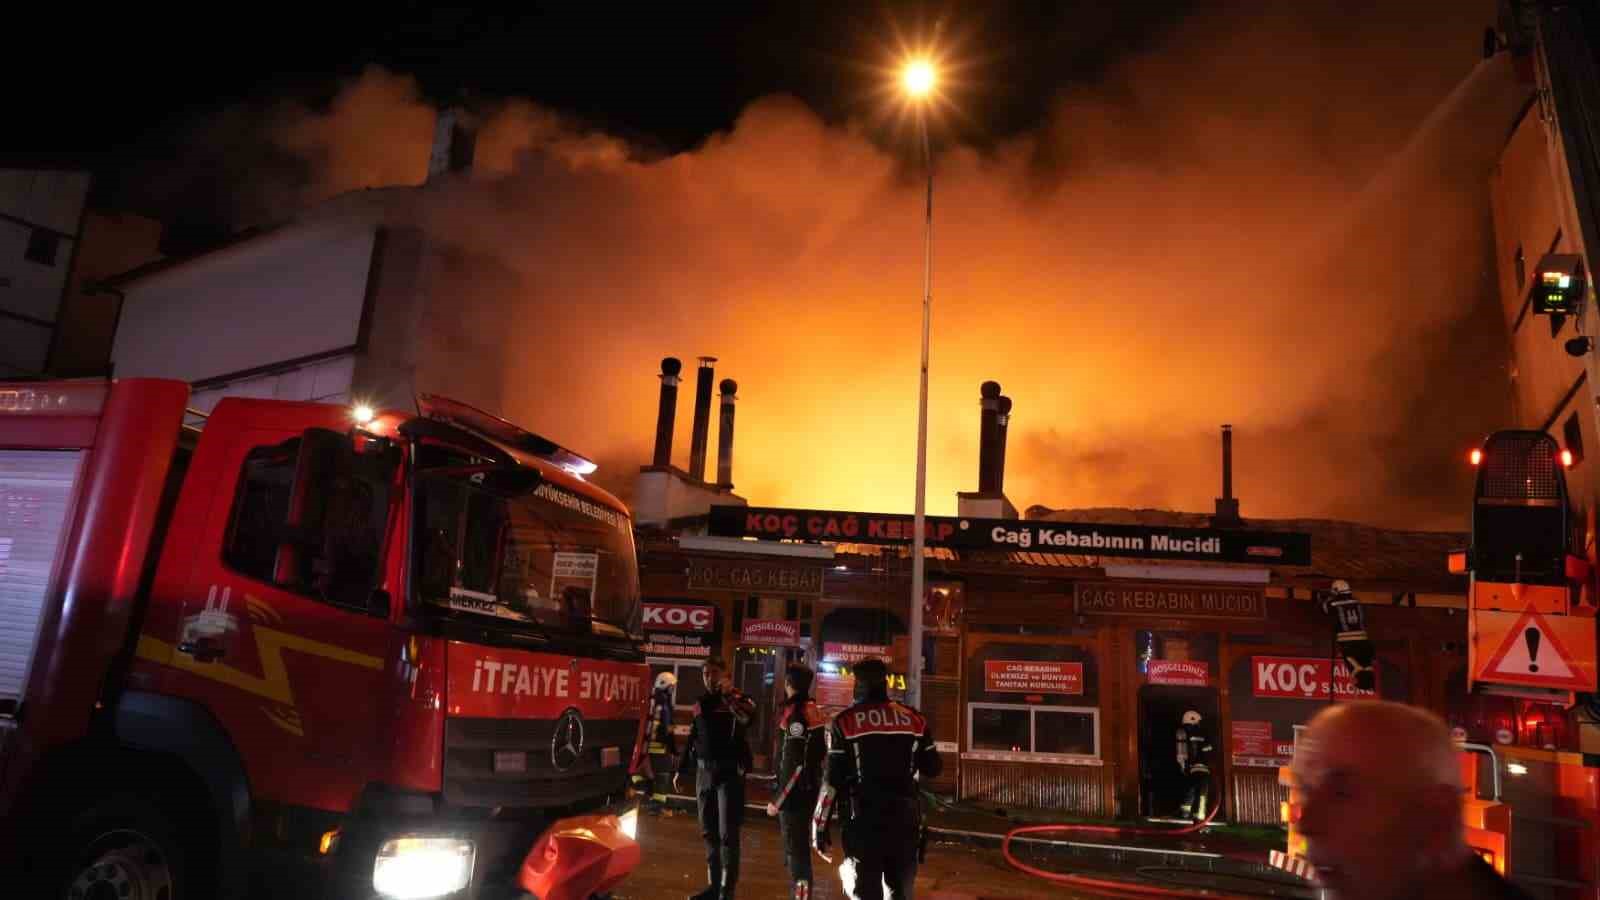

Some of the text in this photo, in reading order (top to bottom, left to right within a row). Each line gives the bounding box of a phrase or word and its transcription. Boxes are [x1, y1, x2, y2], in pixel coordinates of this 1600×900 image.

[745, 514, 798, 537] KOÇ
[991, 527, 1221, 553] Cağ Kebabının Mucidi
[642, 607, 709, 629] KOÇ
[472, 659, 569, 698] İTFAİYE
[1256, 662, 1317, 696] KOÇ
